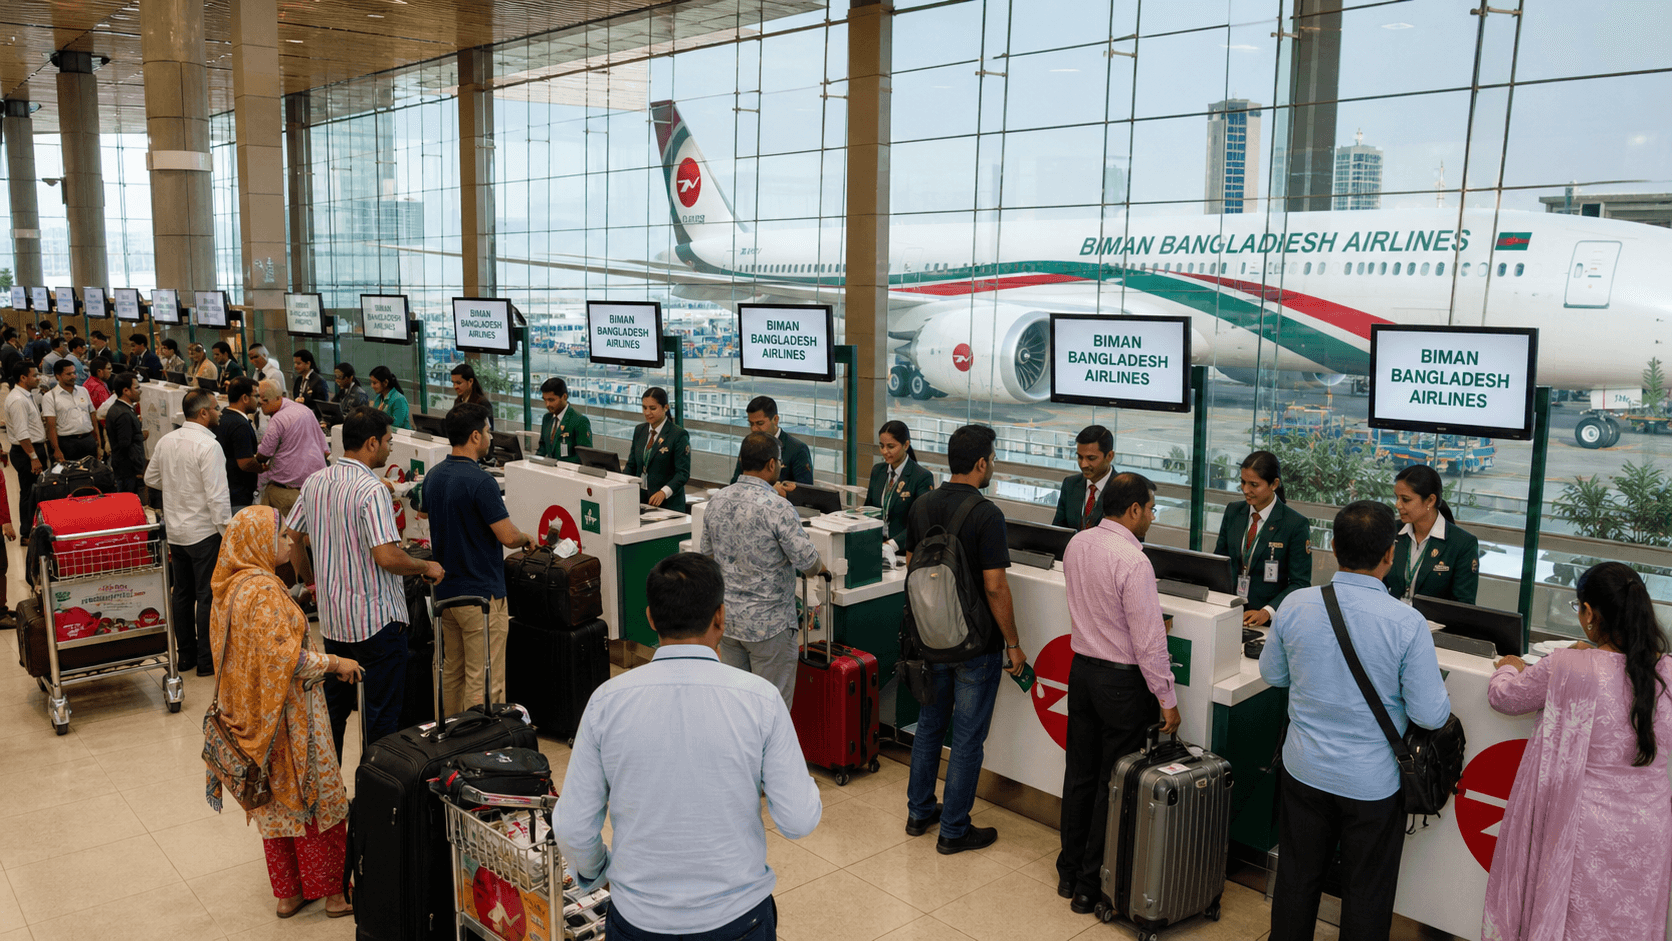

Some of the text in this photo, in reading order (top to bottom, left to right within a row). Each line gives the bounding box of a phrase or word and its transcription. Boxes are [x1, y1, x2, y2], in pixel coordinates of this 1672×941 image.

[1079, 236, 1155, 255] BIMAN
[1342, 229, 1471, 252] AIRLINES
[610, 314, 635, 325] BIMAN
[766, 319, 800, 332] BIMAN
[597, 326, 649, 338] BANGLADESH
[606, 338, 641, 350] AIRLINES
[750, 333, 817, 347] BANGLADESH
[1093, 334, 1142, 349] BIMAN
[761, 348, 806, 361] AIRLINES
[1068, 350, 1169, 369] BANGLADESH
[1420, 348, 1479, 366] BIMAN
[1084, 368, 1150, 386] AIRLINES
[1390, 367, 1510, 389] BANGLADESH
[1408, 389, 1488, 409] AIRLINES
